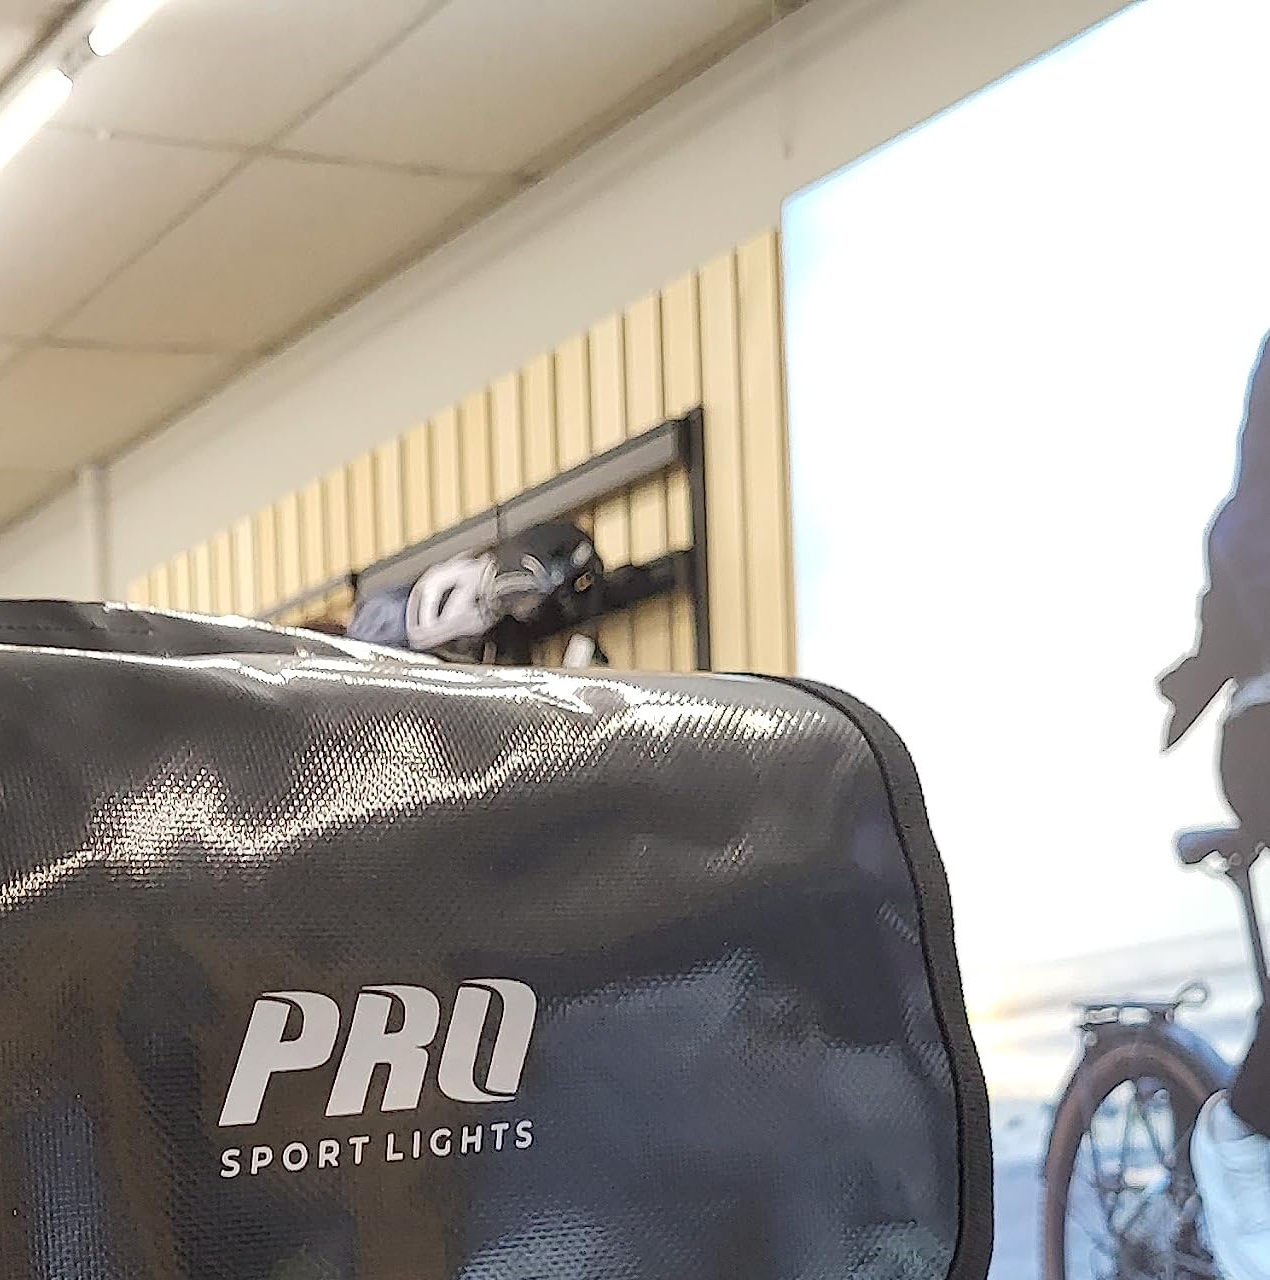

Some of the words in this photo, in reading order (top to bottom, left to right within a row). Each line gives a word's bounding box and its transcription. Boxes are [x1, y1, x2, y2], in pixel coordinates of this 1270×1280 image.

[218, 976, 537, 1127] PRO
[220, 1135, 370, 1178] SPORT
[385, 1120, 534, 1162] LIGHTS
